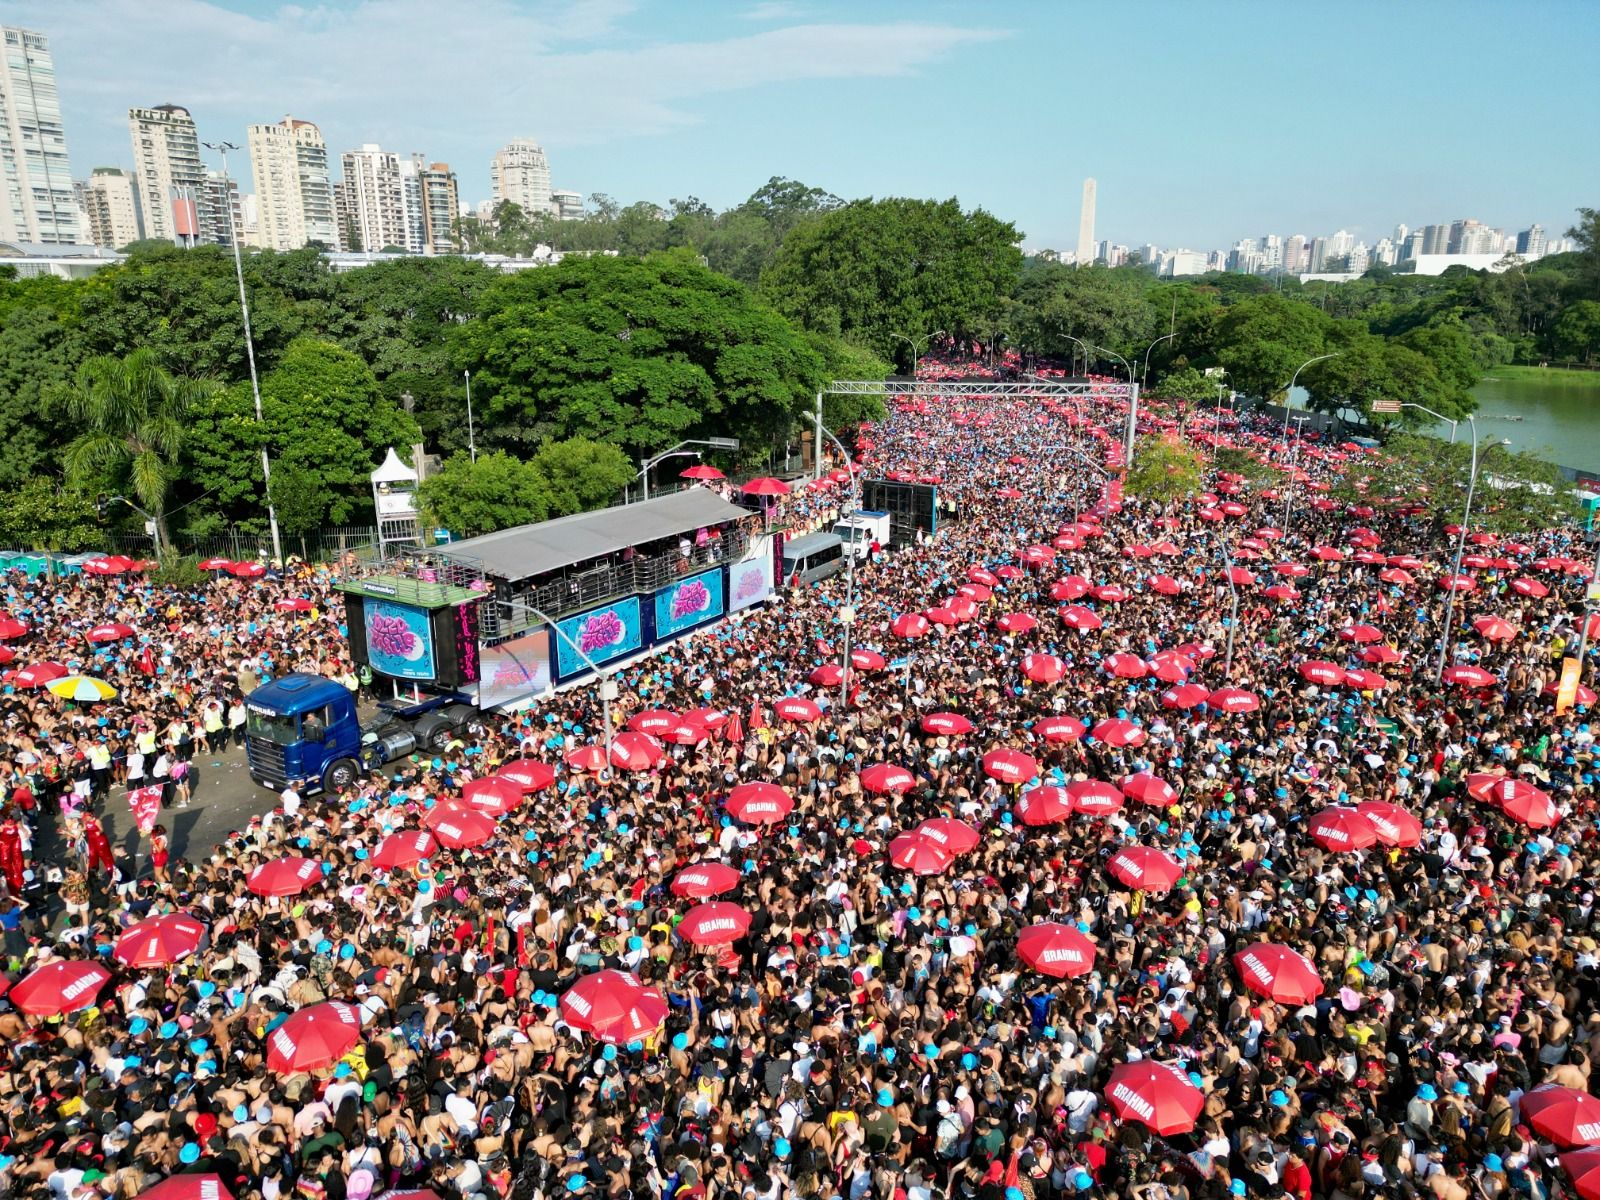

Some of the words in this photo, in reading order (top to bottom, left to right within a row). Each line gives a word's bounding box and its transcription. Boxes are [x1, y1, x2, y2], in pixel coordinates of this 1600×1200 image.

[642, 719, 668, 727] BRAHMA
[930, 719, 953, 727] BRAHMA
[992, 762, 1019, 777] BRAHMA
[747, 803, 776, 812] BRAHMA
[1081, 796, 1112, 805] BRAHMA
[1367, 813, 1398, 836] BRAHMA
[920, 827, 947, 844] BRAHMA
[1317, 826, 1348, 842] BRAHMA
[679, 874, 708, 886] BRAHMA
[699, 919, 735, 934] BRAHMA
[1043, 950, 1082, 962] BRAHMA
[1243, 953, 1273, 985] BRAHMA
[62, 972, 103, 1000] BRAHMA
[1113, 1083, 1154, 1120] BRAHMA
